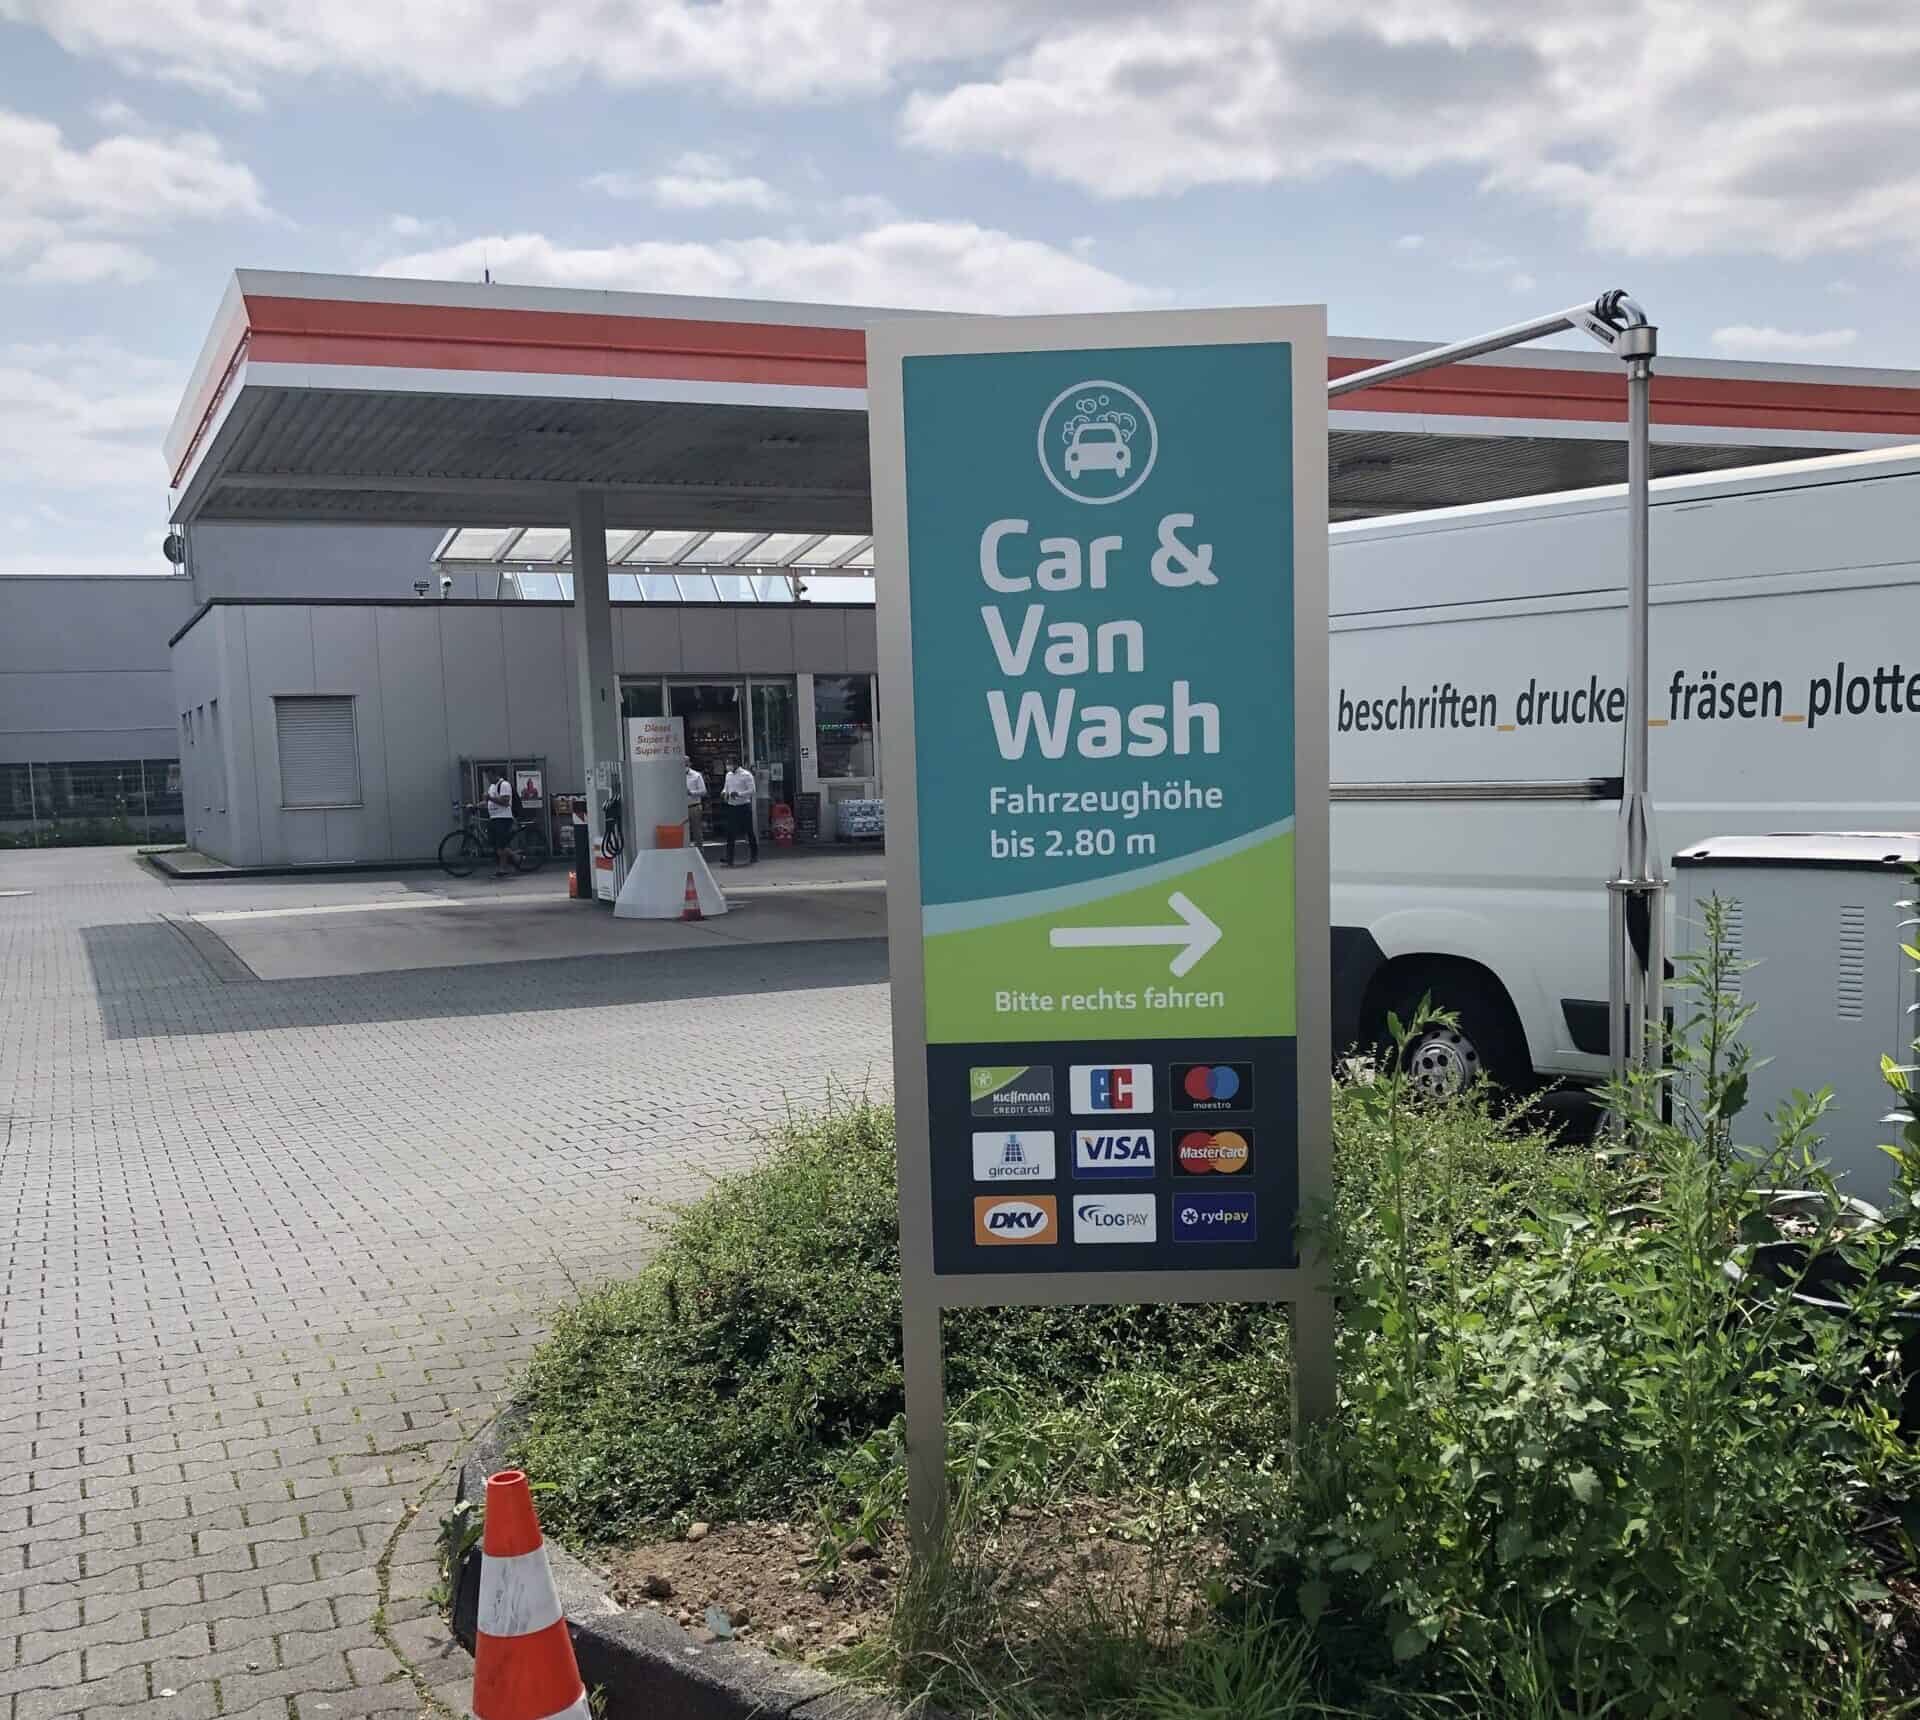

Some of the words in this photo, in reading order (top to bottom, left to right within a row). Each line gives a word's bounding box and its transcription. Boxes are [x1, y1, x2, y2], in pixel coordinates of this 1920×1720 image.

[979, 518, 1123, 594] Car
[1150, 512, 1219, 588] &
[979, 603, 1145, 677] Van
[986, 680, 1221, 761] Wash
[989, 779, 1224, 820] Fahrzeughöhe
[990, 828, 1036, 859] bis
[1044, 828, 1116, 857] 2.80
[1126, 832, 1156, 855] m
[995, 989, 1054, 1012] Bitte
[1061, 987, 1137, 1011] rechts
[1143, 986, 1225, 1010] fahren
[993, 1105, 1025, 1115] CREDIT
[1027, 1105, 1051, 1114] CARD
[1192, 1102, 1232, 1110] maestro
[1083, 1135, 1152, 1161] VISA
[1179, 1145, 1248, 1160] MasterCard
[988, 1163, 1041, 1178] girocard
[988, 1211, 1045, 1229] DKV
[1094, 1212, 1149, 1227] LOGPAY
[1201, 1209, 1249, 1225] rydpay
